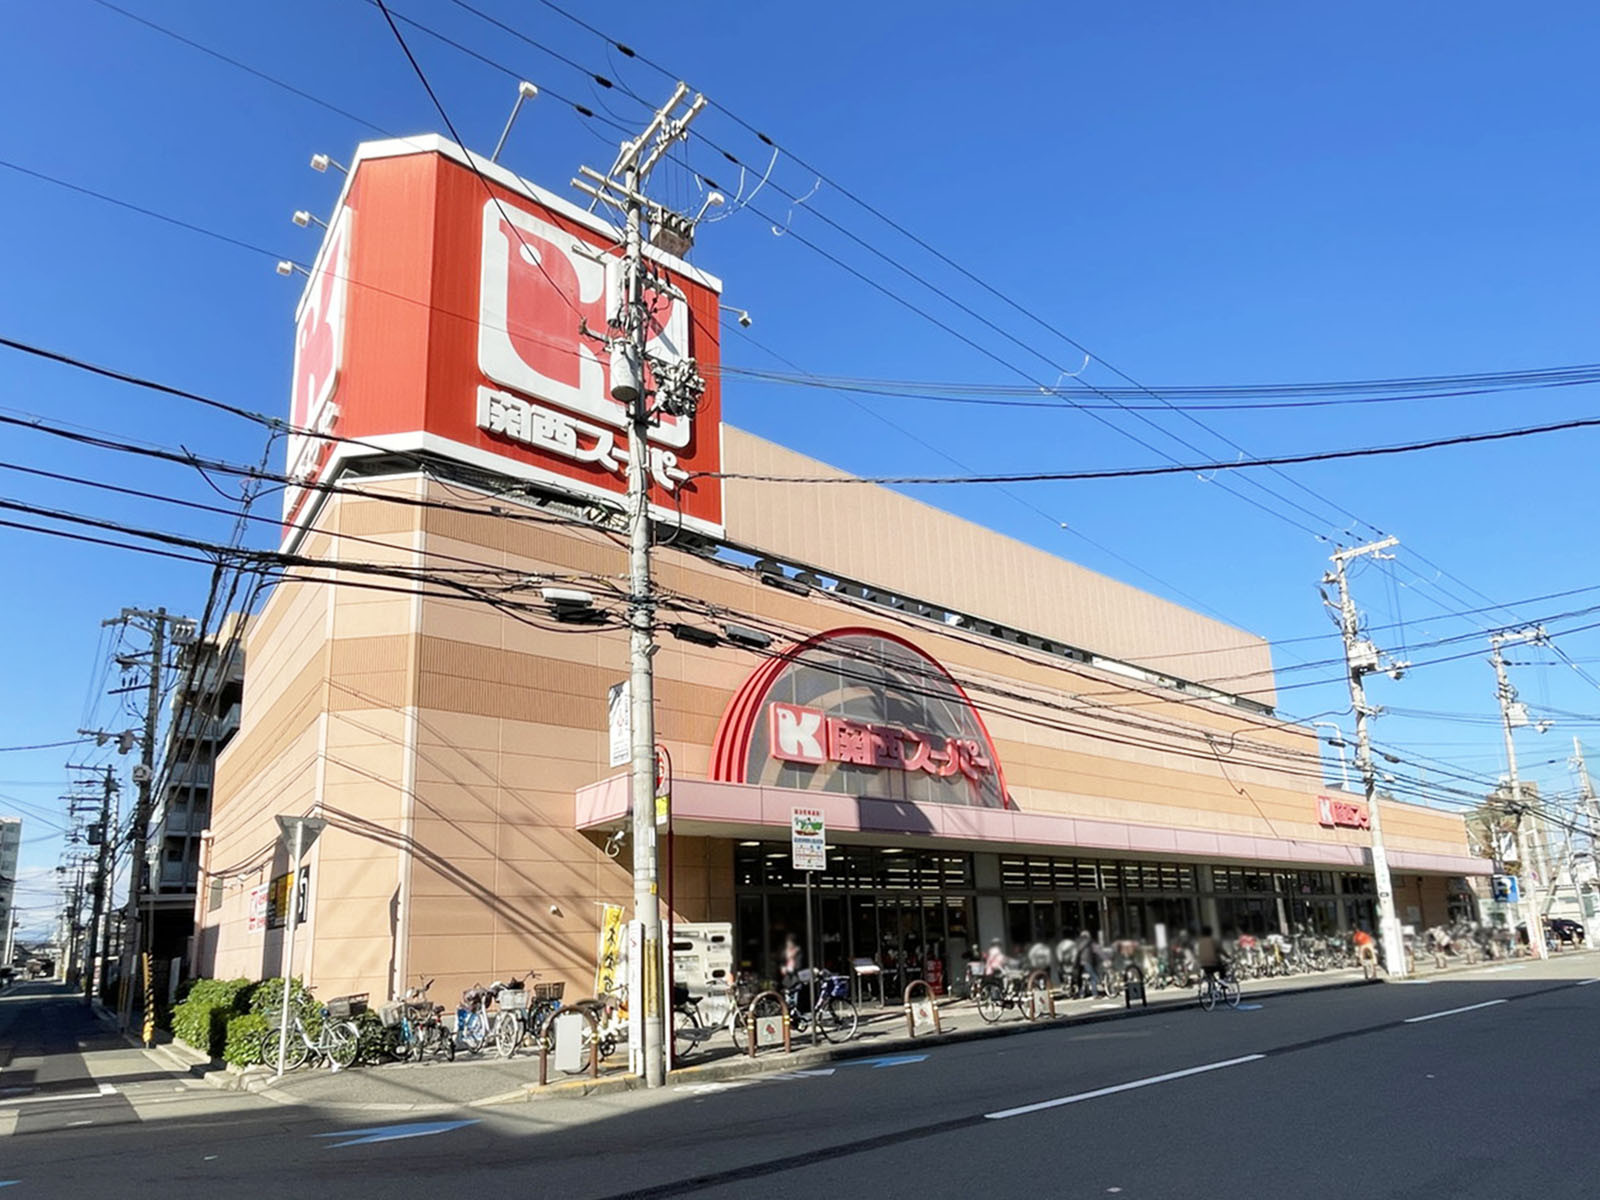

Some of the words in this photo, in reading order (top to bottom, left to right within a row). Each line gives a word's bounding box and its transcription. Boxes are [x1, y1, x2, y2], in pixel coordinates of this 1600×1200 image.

[827, 716, 992, 780] 関西スーパー
